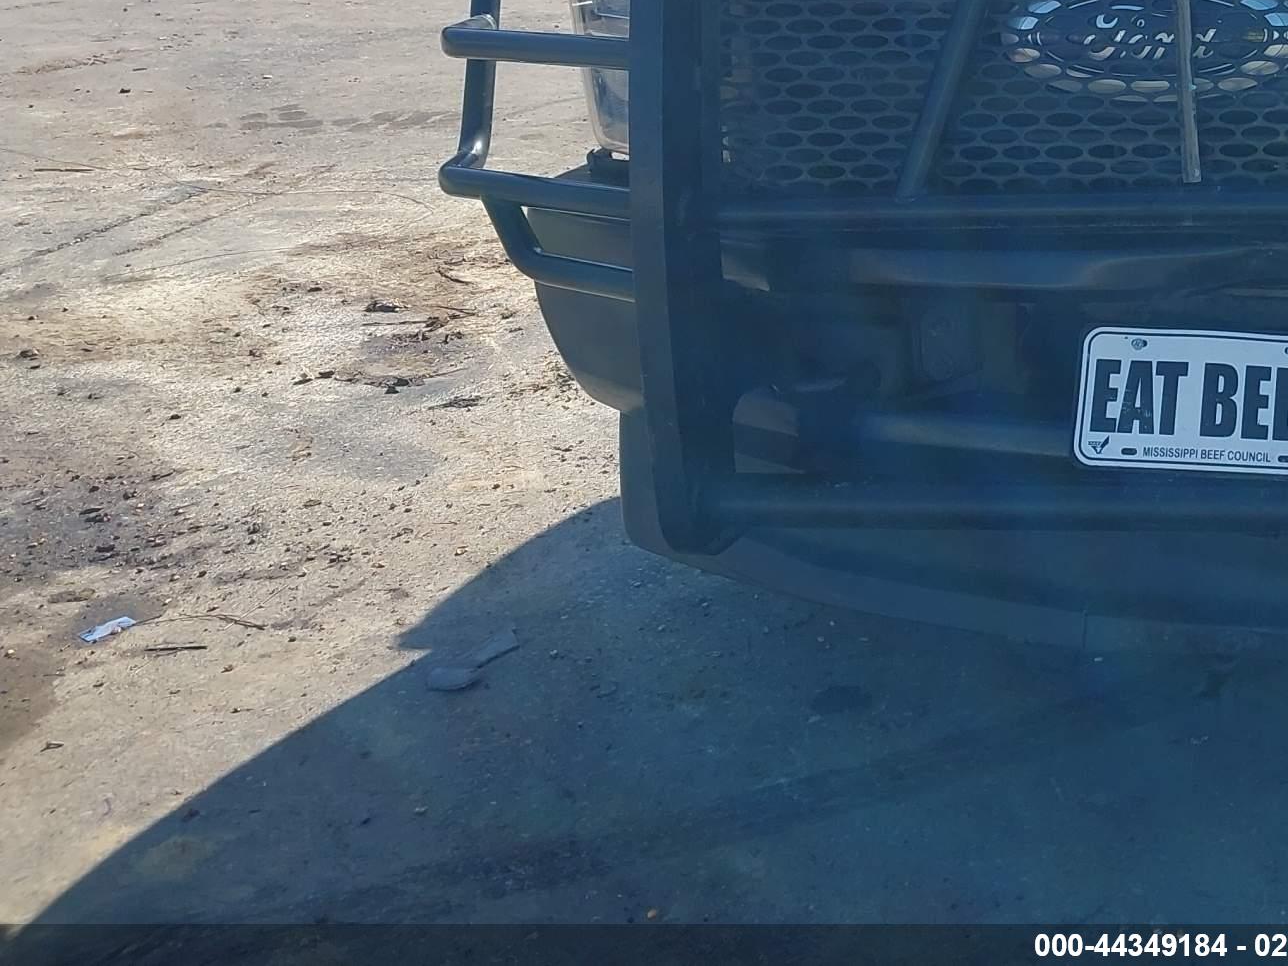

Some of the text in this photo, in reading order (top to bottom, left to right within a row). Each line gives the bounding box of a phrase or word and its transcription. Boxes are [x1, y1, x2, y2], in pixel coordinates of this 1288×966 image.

[1089, 358, 1189, 436] EAT
[1142, 446, 1272, 463] MISSISSIPPI BEEF COUNCIL
